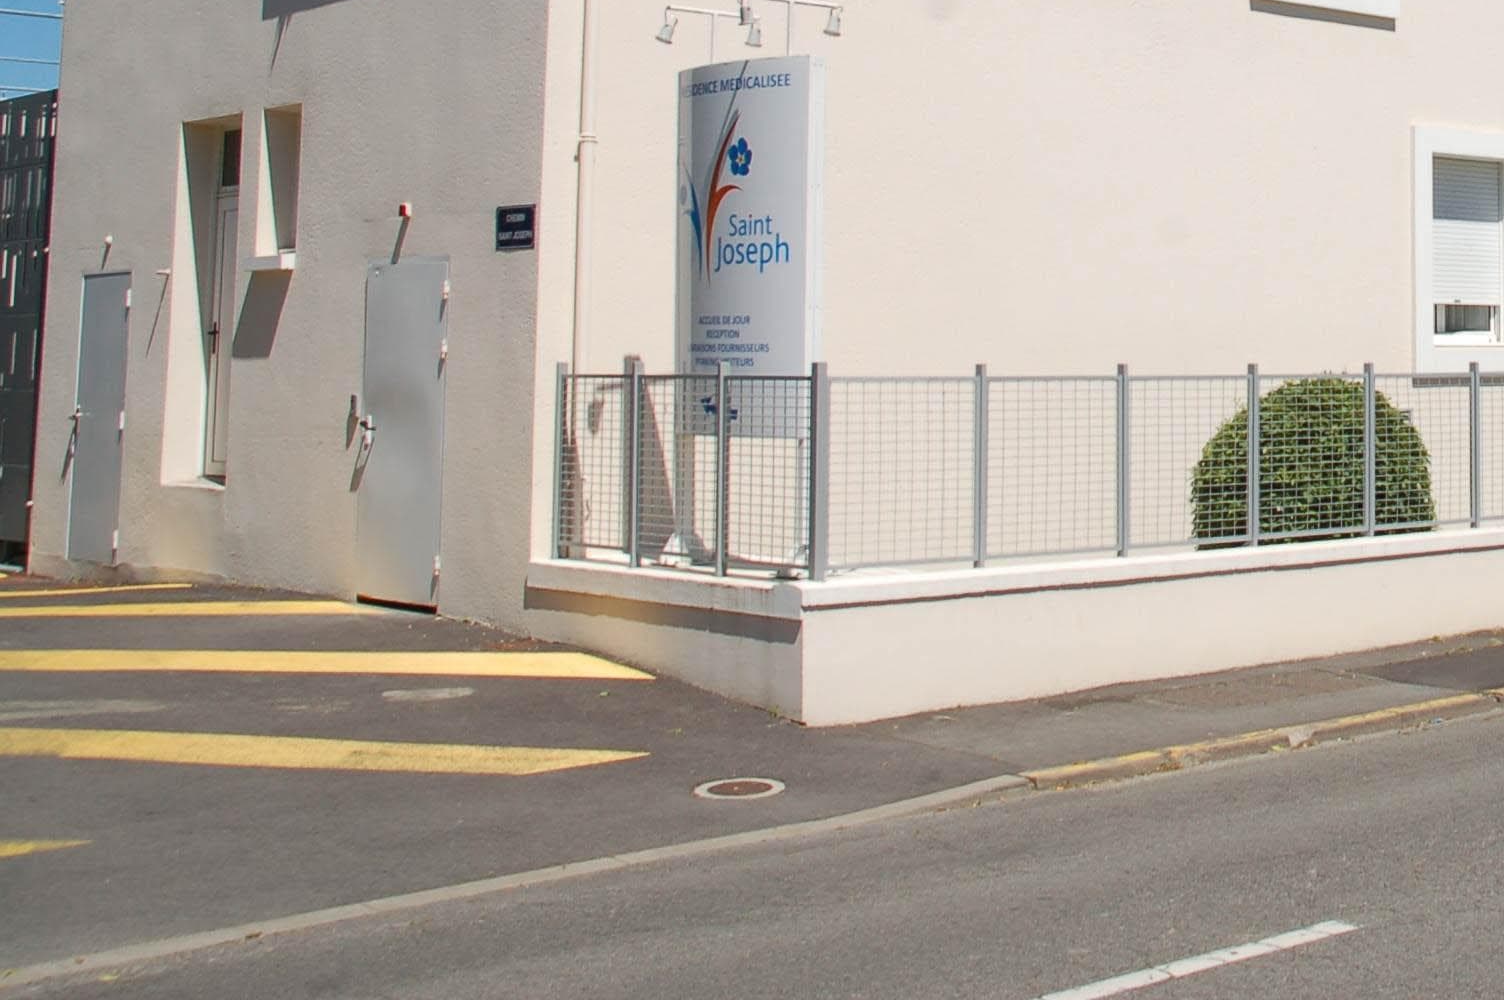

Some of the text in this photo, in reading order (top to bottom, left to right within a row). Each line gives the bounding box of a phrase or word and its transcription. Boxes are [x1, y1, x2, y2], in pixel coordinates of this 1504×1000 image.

[720, 73, 791, 92] MEDICALISEE
[729, 213, 773, 237] Saint
[714, 232, 790, 274] Joseph
[732, 314, 750, 325] JOUR
